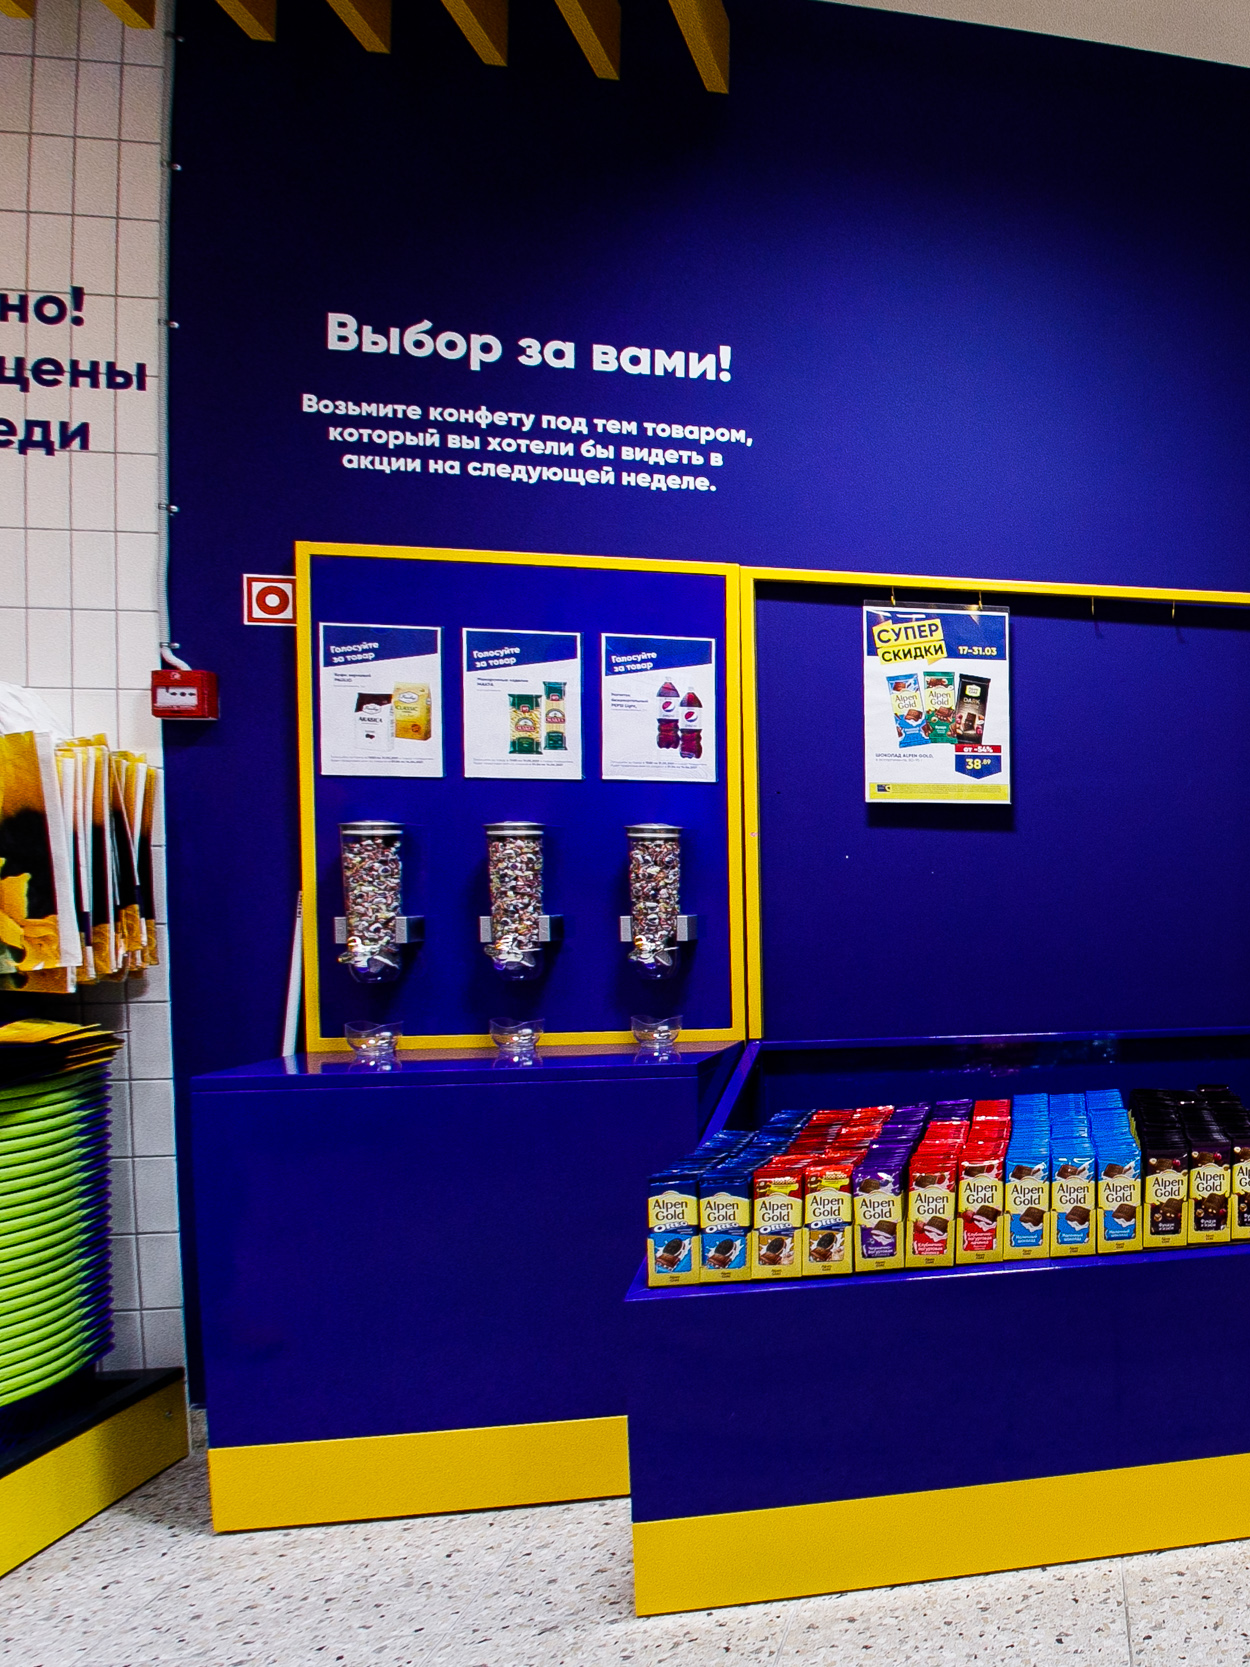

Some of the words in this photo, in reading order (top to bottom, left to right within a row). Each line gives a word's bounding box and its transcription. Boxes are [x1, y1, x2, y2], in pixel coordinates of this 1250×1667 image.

[327, 312, 503, 371] Выбор
[517, 337, 575, 369] за
[592, 344, 732, 382] вами!
[302, 393, 422, 419] Возьмите
[429, 405, 535, 431] конфету
[542, 414, 588, 435] под
[593, 418, 638, 435] тем
[643, 421, 753, 447] товаром,
[329, 427, 440, 449] который
[447, 434, 481, 450] вы
[487, 436, 574, 456] хотели
[580, 439, 615, 459] бы
[621, 446, 705, 466] видеть
[710, 452, 724, 467] в
[342, 454, 421, 474] акции
[428, 459, 461, 475] на
[467, 461, 615, 486] следующей
[621, 471, 717, 492] неделе.
[876, 623, 940, 644] СУПЕР
[330, 641, 379, 653] Голосуйте
[473, 646, 521, 659] Голосуйте
[346, 652, 375, 662] товар
[611, 651, 657, 663] Голосуйте
[881, 644, 945, 663] СКИДКИ
[488, 657, 516, 667] товар
[626, 662, 653, 672] товар
[895, 694, 918, 703] Alpen
[928, 691, 951, 699] Alpen
[898, 701, 917, 709] Gold
[930, 698, 949, 706] Gold
[1152, 1177, 1184, 1189] Alpen
[1194, 1171, 1225, 1183] Alpen
[964, 1182, 998, 1194] Alpen
[1011, 1184, 1044, 1196] Alpen
[1057, 1183, 1090, 1194] Alpen
[1103, 1182, 1136, 1193] Alpen
[1154, 1187, 1181, 1198] Gold
[1196, 1181, 1222, 1193] Gold
[810, 1196, 844, 1207] Alpen
[915, 1193, 949, 1204] Alpen
[966, 1192, 994, 1204] Gold
[1013, 1195, 1041, 1206] Gold
[1059, 1193, 1086, 1205] Gold
[1106, 1191, 1133, 1203] Gold
[652, 1199, 688, 1211] Alpen
[704, 1200, 739, 1212] Alpen
[759, 1200, 793, 1212] Alpen
[860, 1199, 895, 1210] Alpen
[917, 1203, 946, 1215] Gold
[655, 1209, 685, 1221] Gold
[707, 1210, 736, 1222] Gold
[762, 1210, 790, 1222] Gold
[813, 1206, 841, 1218] Gold
[863, 1207, 892, 1219] Gold
[653, 1221, 688, 1233] OREO
[705, 1222, 740, 1233] OREO
[759, 1222, 793, 1234] OREO
[810, 1217, 843, 1229] OREO
